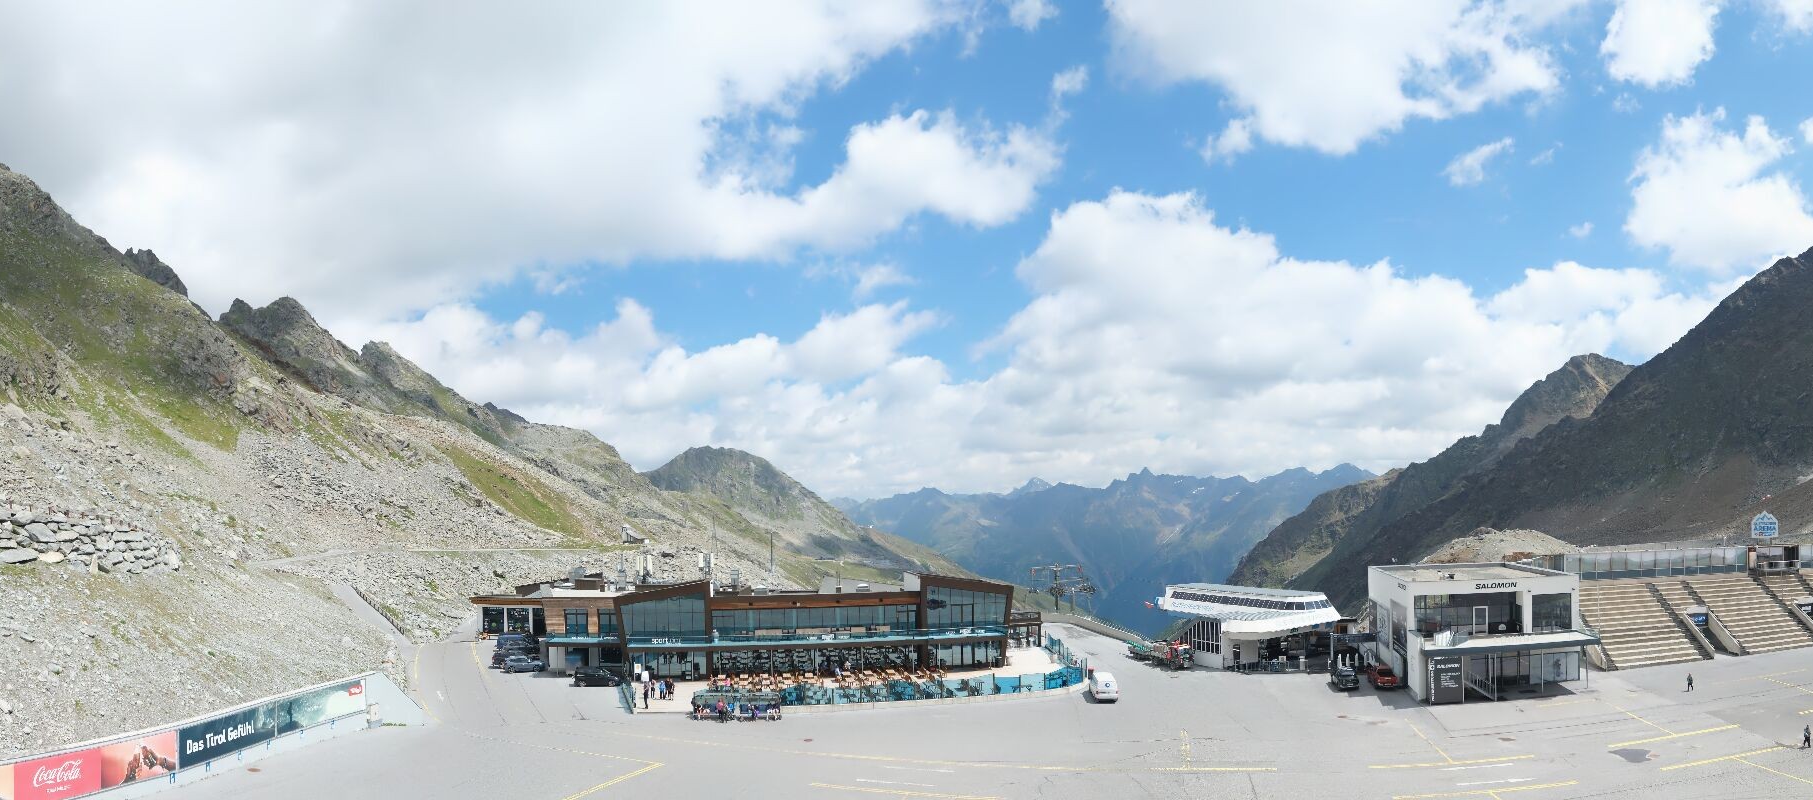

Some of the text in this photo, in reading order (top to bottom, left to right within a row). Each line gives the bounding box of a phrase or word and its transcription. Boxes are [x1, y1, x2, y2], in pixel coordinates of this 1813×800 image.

[1475, 582, 1518, 590] SALOMON
[186, 719, 255, 755] Das Tirol Gefühl
